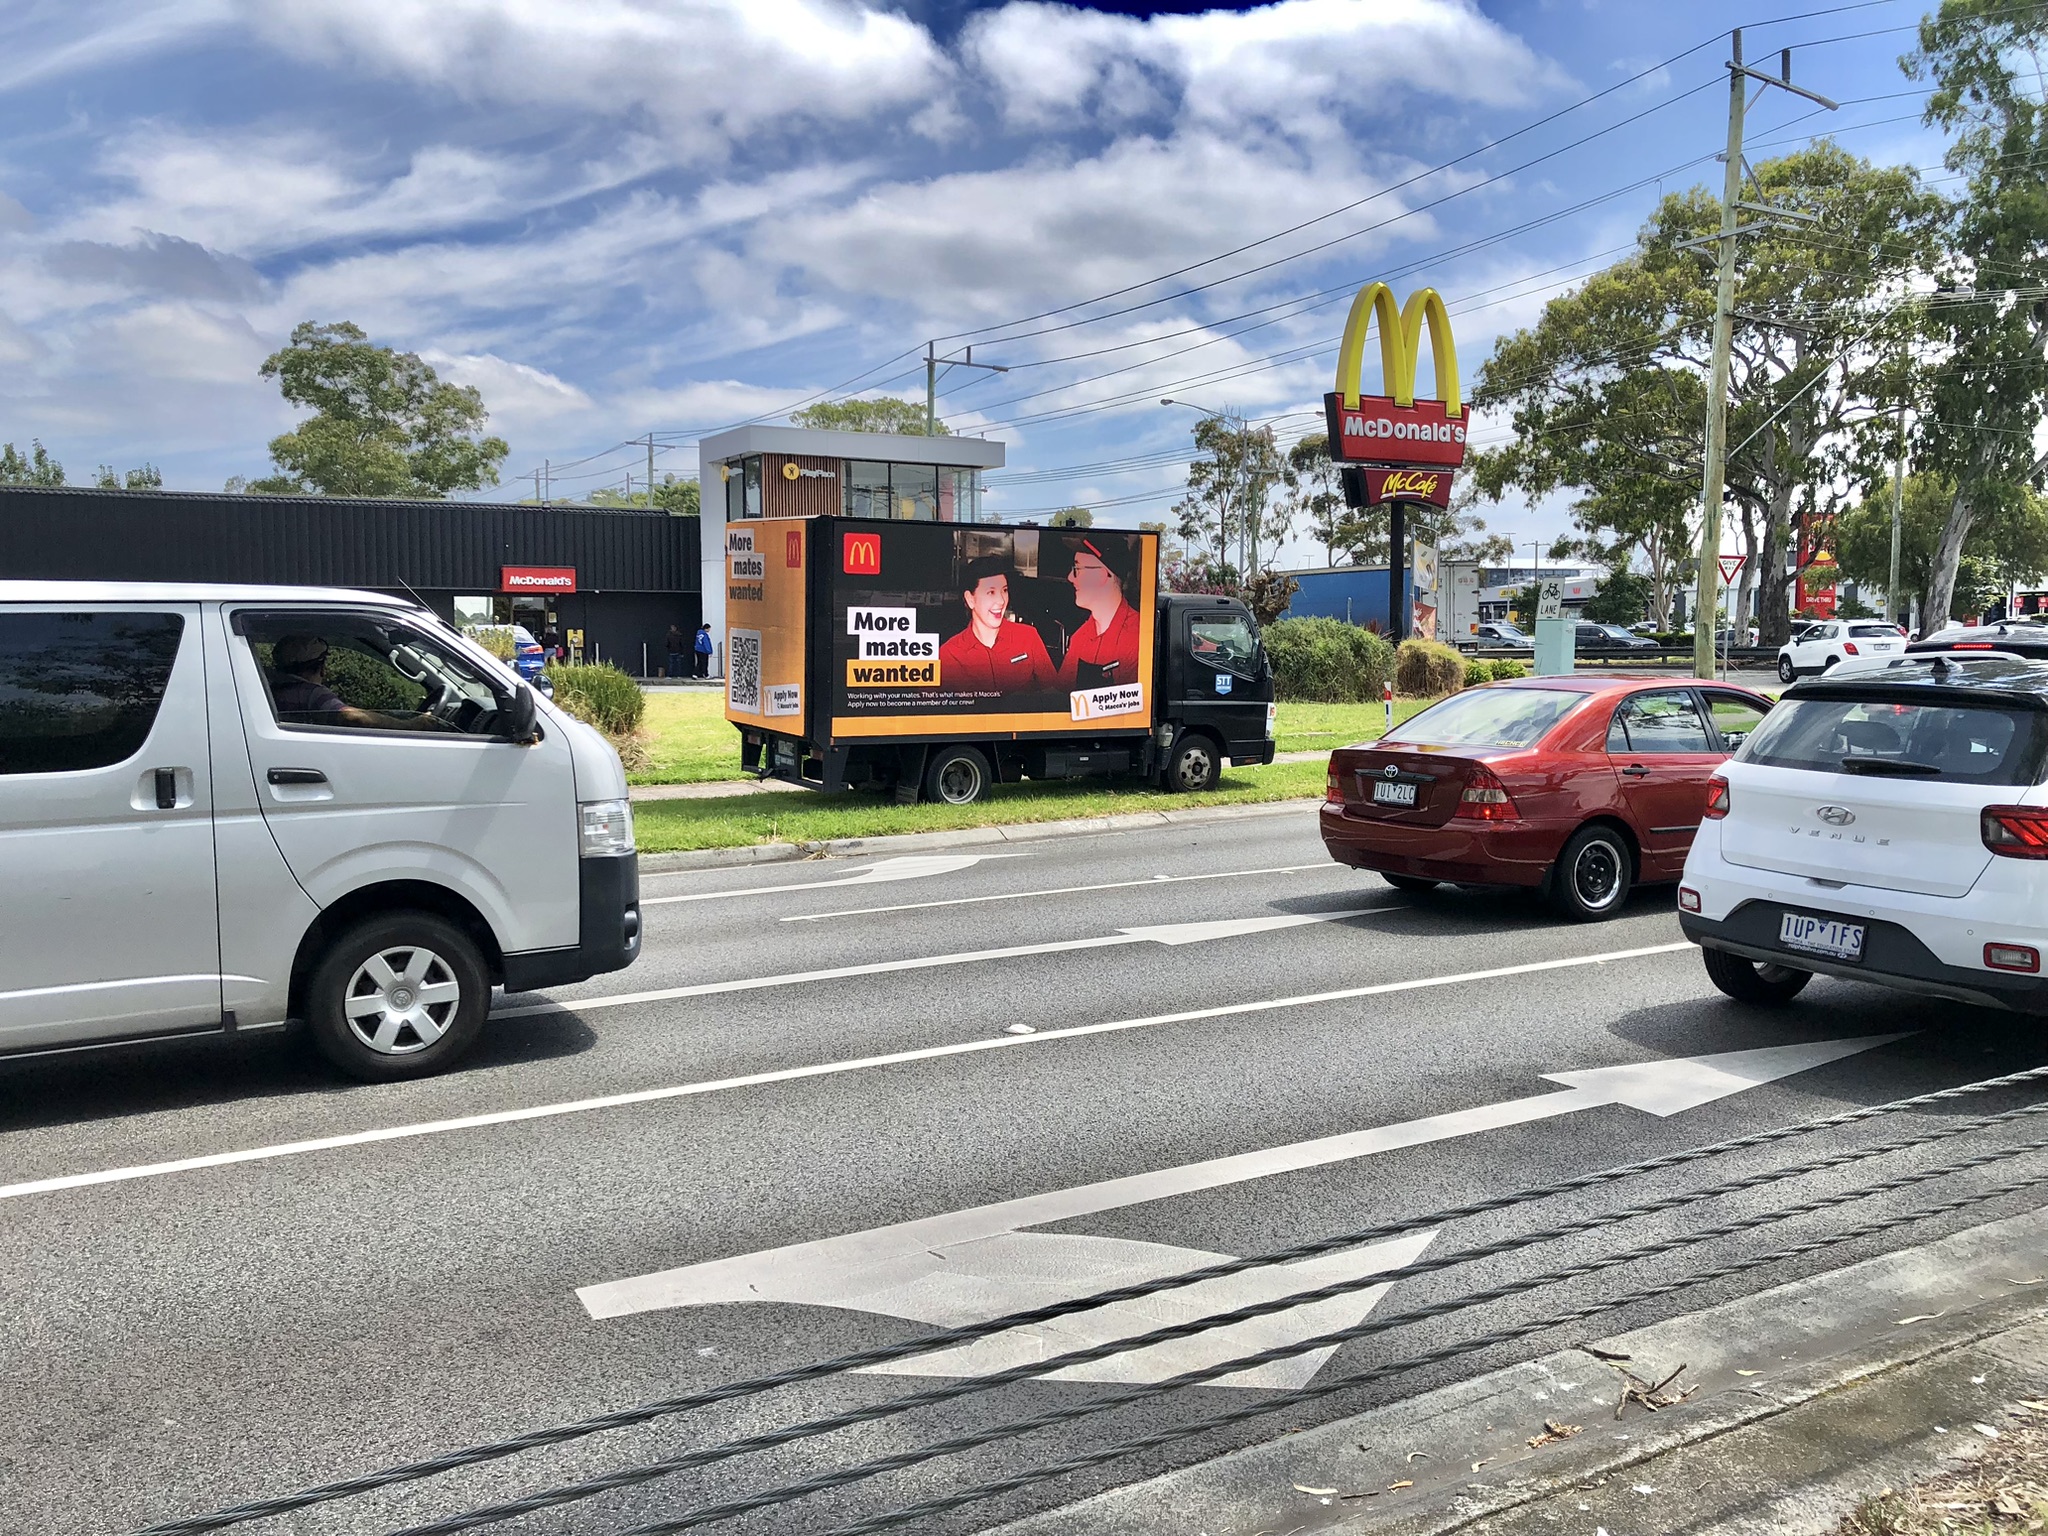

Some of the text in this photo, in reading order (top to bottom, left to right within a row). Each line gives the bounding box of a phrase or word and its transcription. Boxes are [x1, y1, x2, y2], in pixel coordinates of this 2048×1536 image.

[1344, 416, 1465, 443] McDonald's
[1382, 471, 1438, 498] McCafé
[729, 533, 752, 551] More
[733, 558, 762, 576] mates
[509, 575, 572, 586] McDonald's
[729, 583, 763, 601] wanted
[1540, 604, 1558, 615] LANE
[854, 612, 910, 631] More
[866, 638, 933, 656] mates
[853, 663, 935, 682] wanted
[1216, 676, 1232, 686] STT
[773, 690, 788, 702] Apply
[847, 692, 873, 701] Working
[887, 693, 901, 701] your
[954, 690, 973, 698] makes
[847, 700, 865, 709] Apply
[1092, 690, 1139, 704] Apply Now
[1128, 700, 1140, 708] jobs
[1789, 826, 1890, 846] VENUE
[1785, 917, 1862, 949] 1UP 1FS
